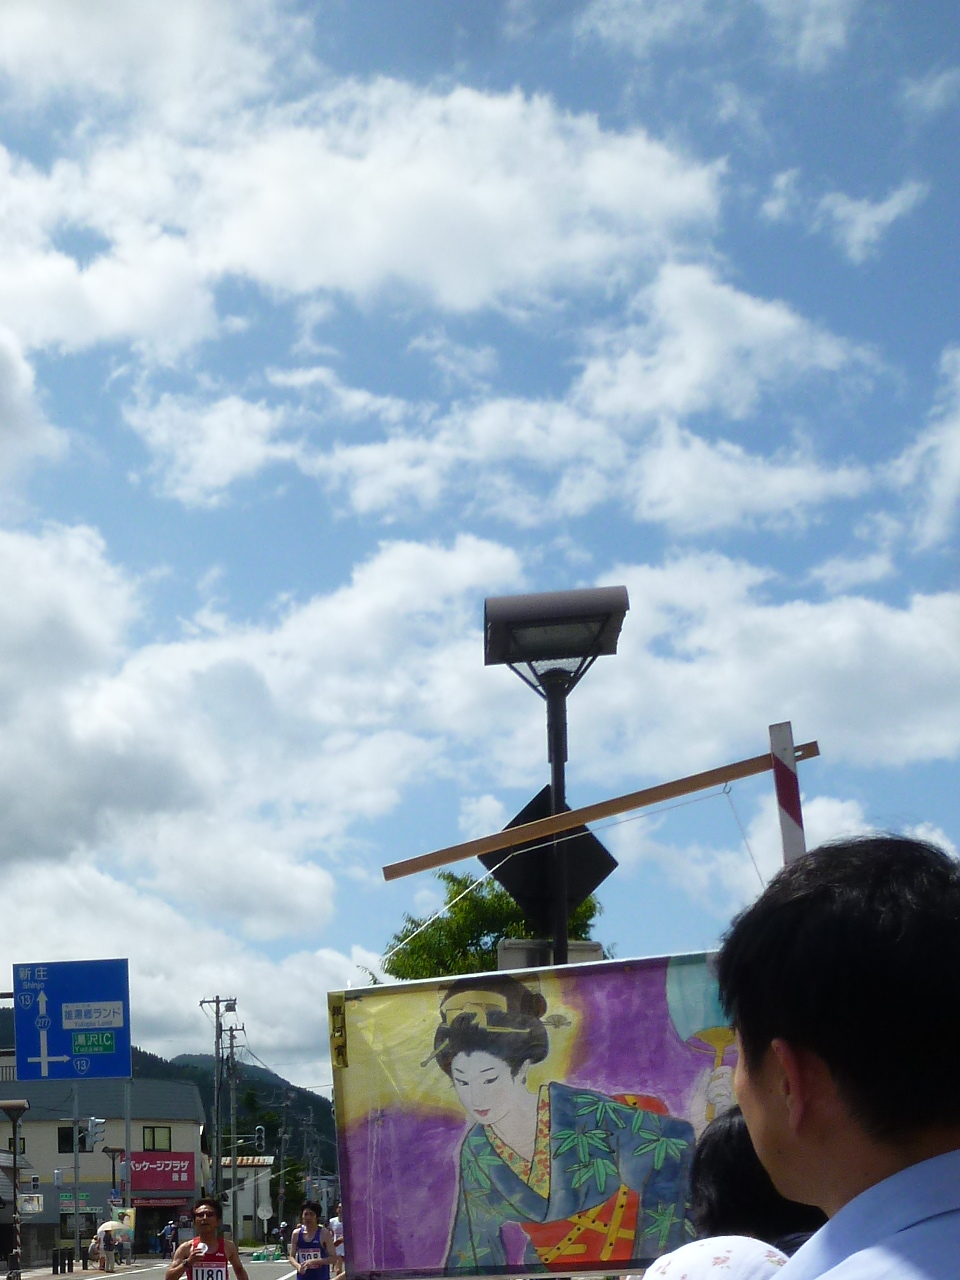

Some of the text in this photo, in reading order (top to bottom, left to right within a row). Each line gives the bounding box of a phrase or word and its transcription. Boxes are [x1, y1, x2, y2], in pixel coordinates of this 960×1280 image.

[19, 967, 48, 980] 新庄
[23, 981, 45, 990] Shinjo
[20, 994, 31, 1005] 13
[76, 1060, 87, 1070] 13
